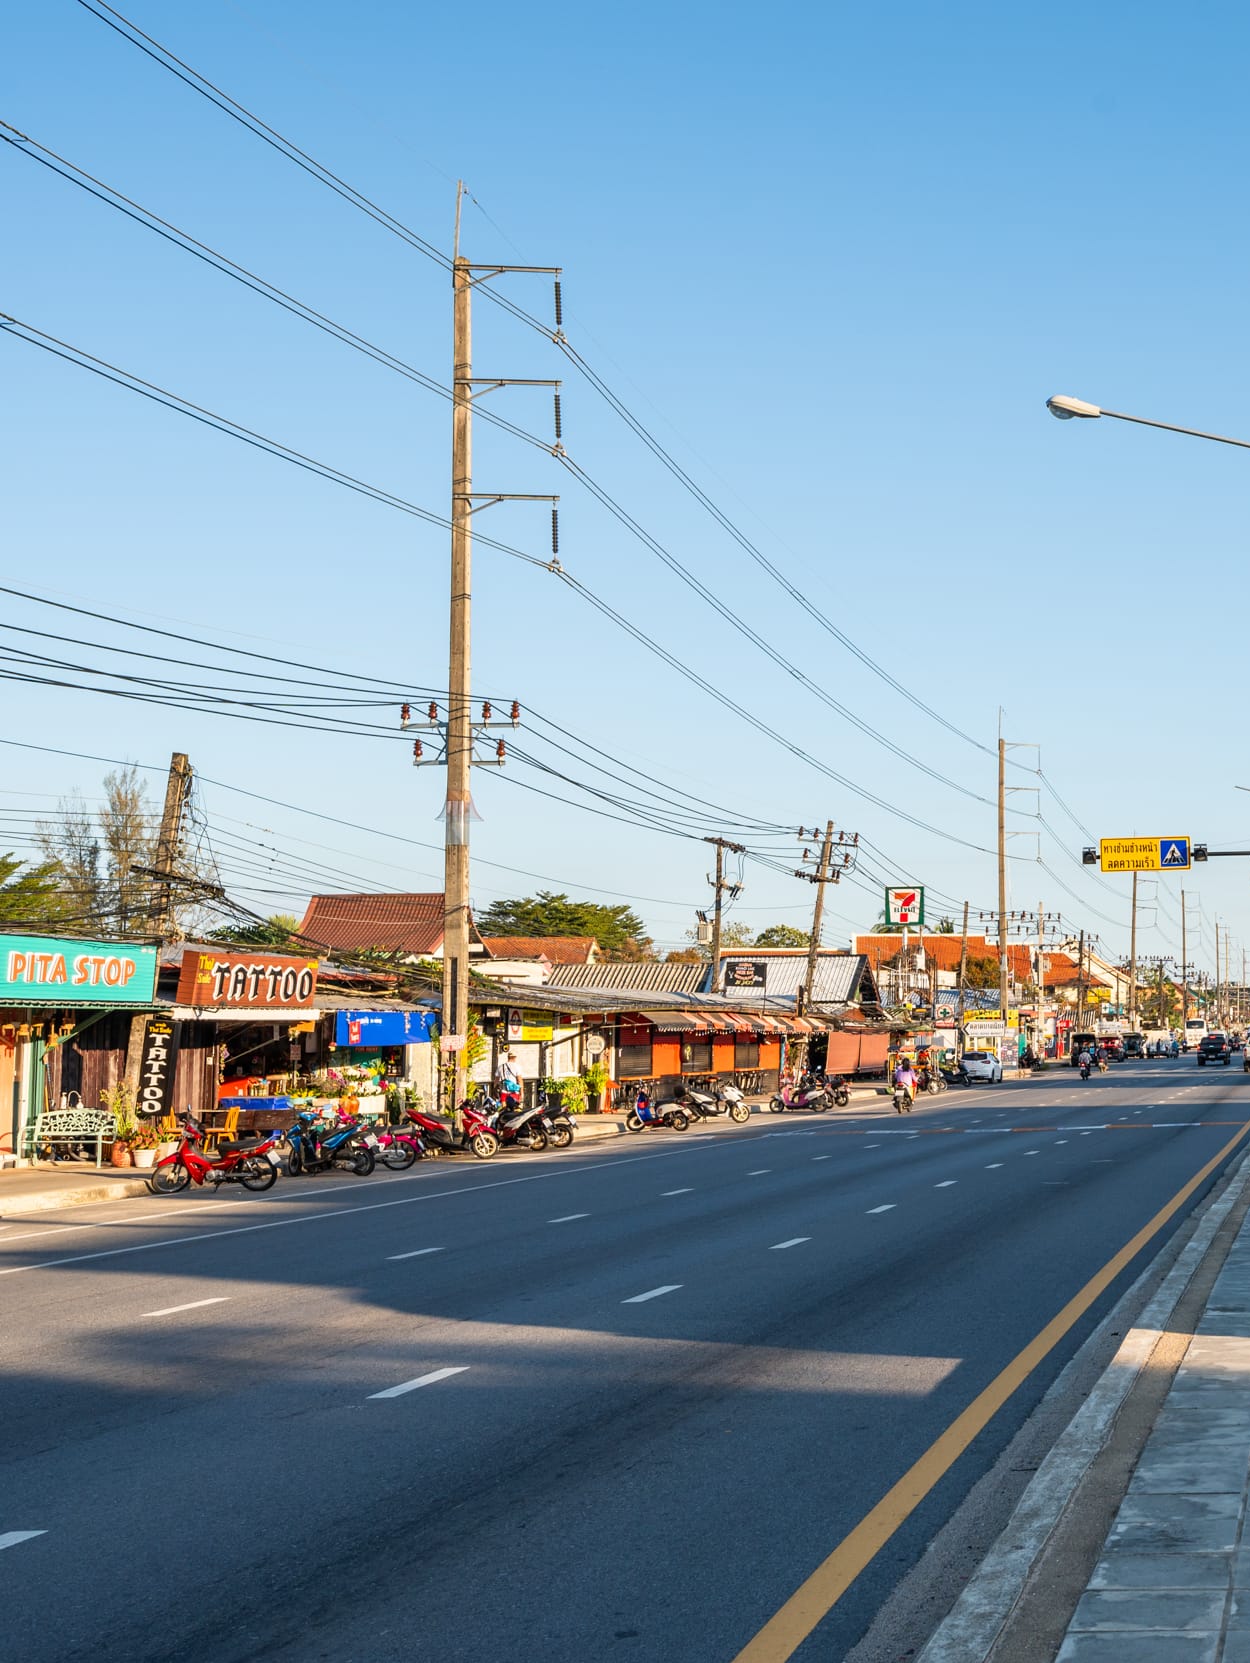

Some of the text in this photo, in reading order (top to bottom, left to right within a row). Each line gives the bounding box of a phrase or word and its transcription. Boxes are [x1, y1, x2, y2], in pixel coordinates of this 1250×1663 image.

[1107, 856, 1155, 869] ลดความเร็ว
[7, 950, 137, 987] PITA STOP
[211, 961, 313, 1003] TATTOO
[142, 1033, 171, 1113] TATTOO
